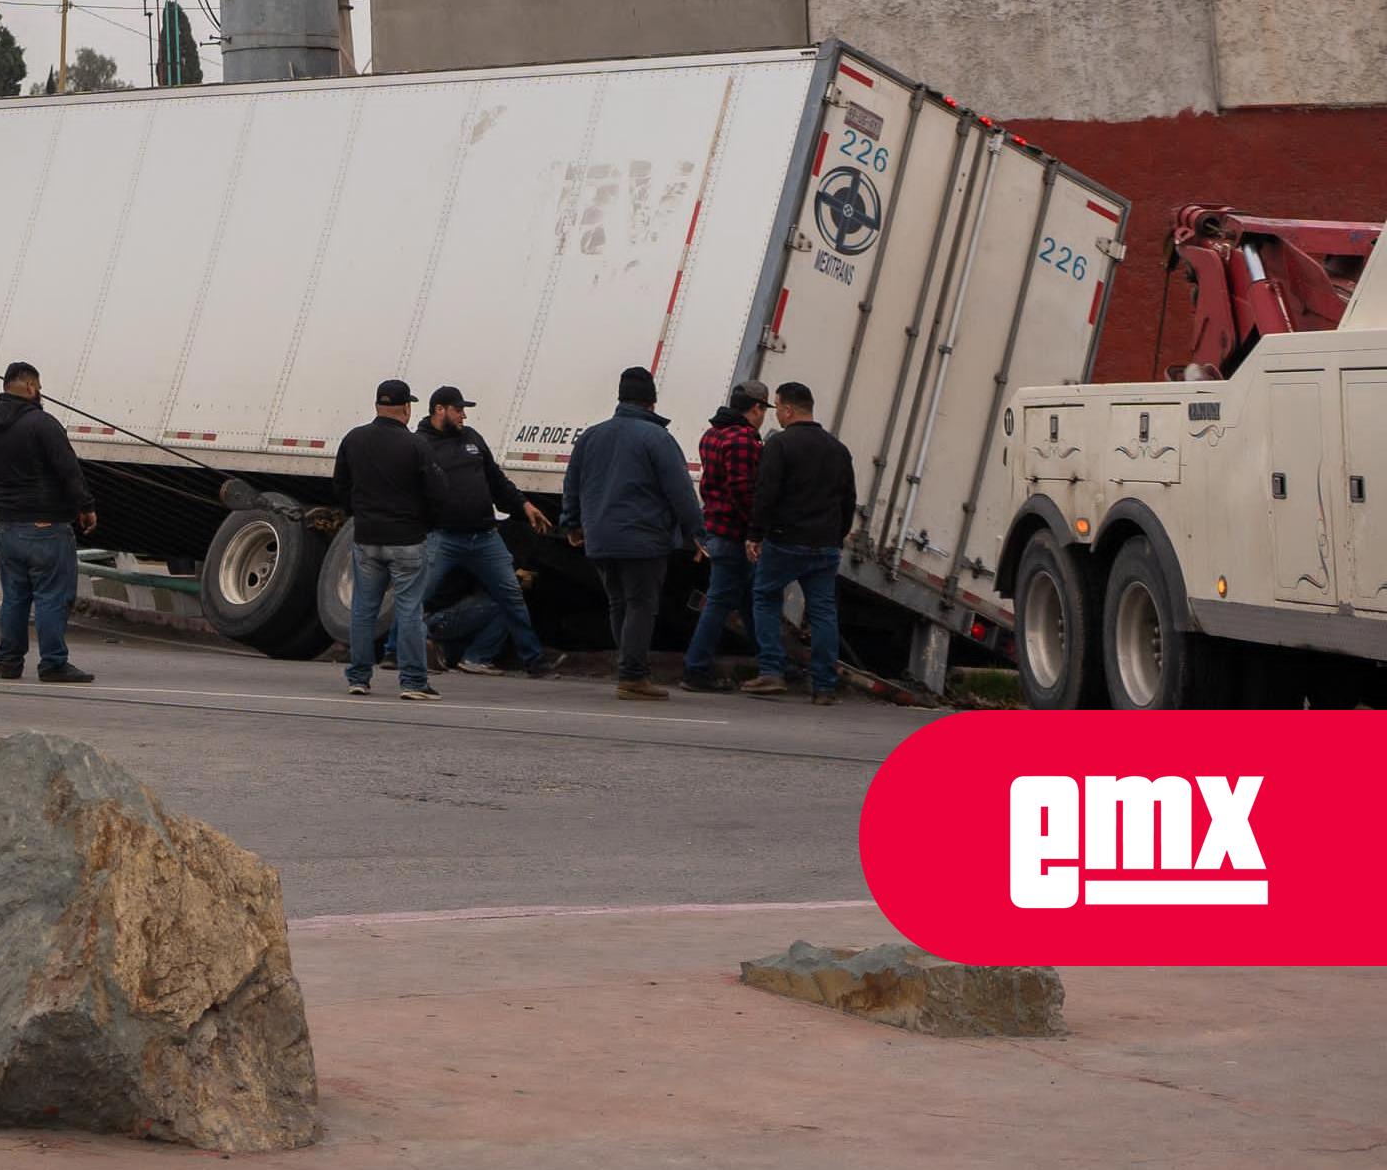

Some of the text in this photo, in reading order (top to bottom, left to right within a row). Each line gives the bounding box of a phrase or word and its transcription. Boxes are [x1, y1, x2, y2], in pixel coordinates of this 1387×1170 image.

[839, 129, 889, 174] 226
[1038, 237, 1088, 281] 226
[515, 425, 540, 442] AIR
[539, 427, 571, 444] RIDE
